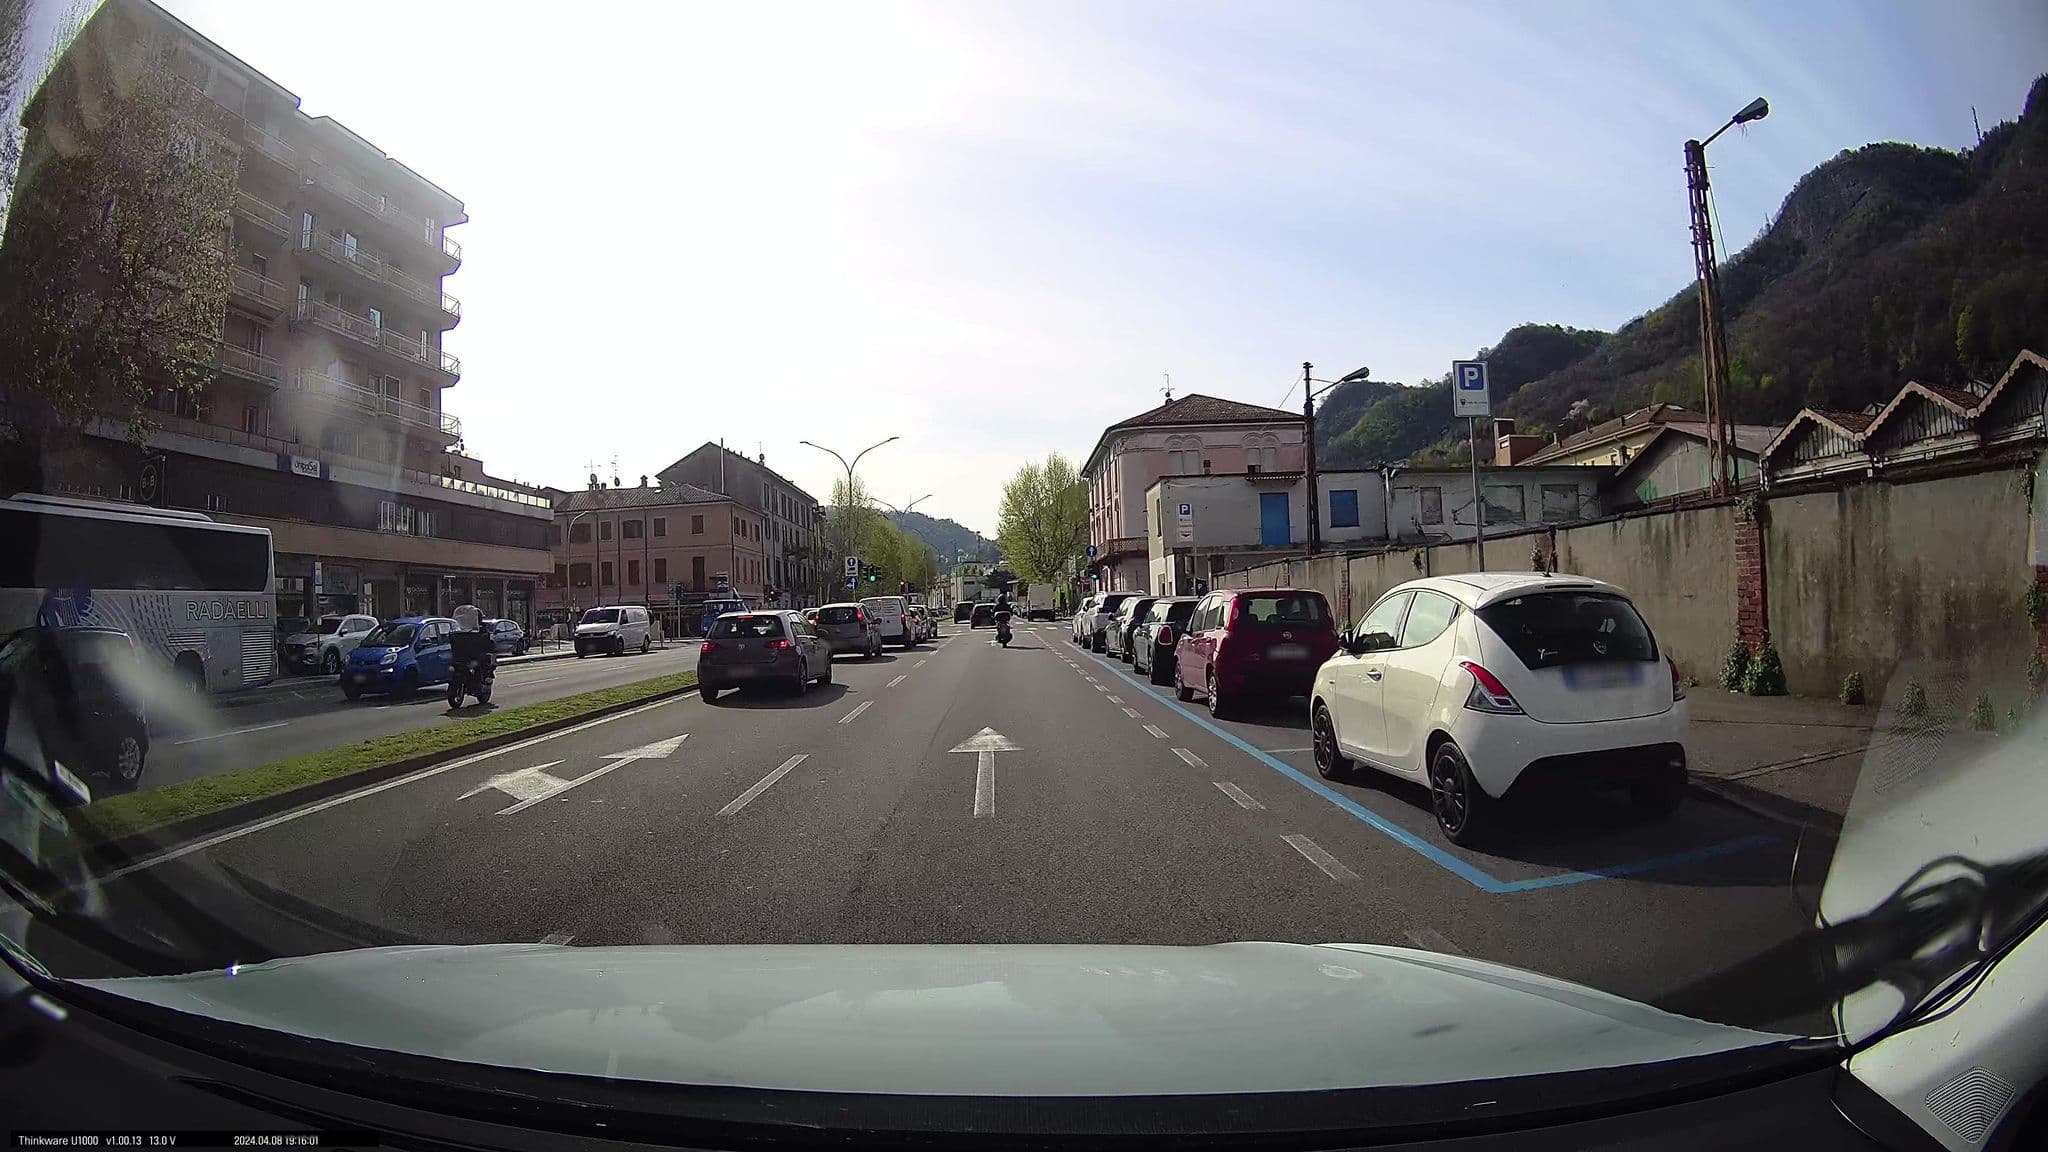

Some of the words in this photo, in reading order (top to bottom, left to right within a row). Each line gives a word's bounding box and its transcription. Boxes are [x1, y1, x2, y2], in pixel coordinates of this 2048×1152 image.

[1464, 367, 1479, 387] P
[1181, 504, 1189, 514] P
[186, 601, 268, 620] RADAELLI
